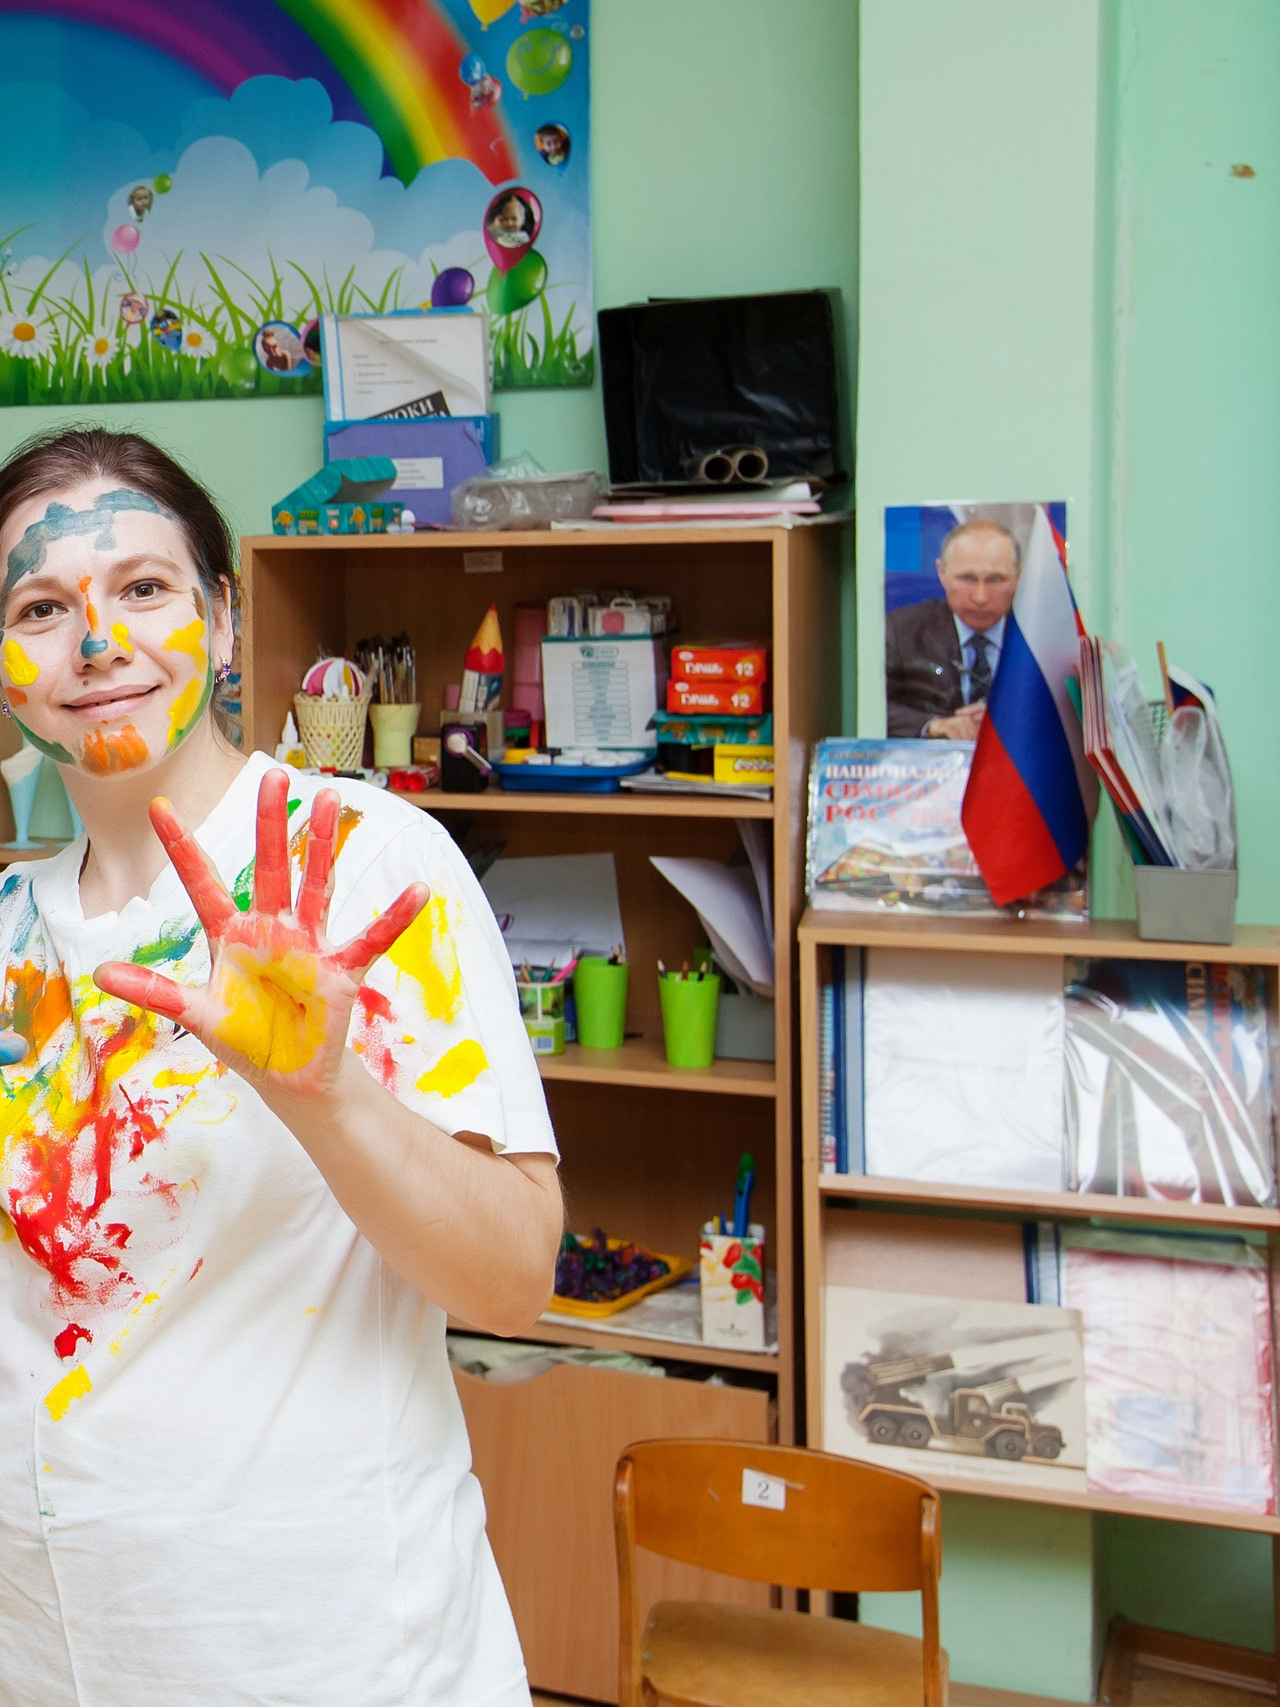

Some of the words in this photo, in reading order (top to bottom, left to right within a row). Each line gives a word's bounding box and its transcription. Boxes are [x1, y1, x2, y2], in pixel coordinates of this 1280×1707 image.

[735, 661, 754, 677] 12
[731, 693, 750, 709] 12
[757, 1479, 769, 1501] 2
